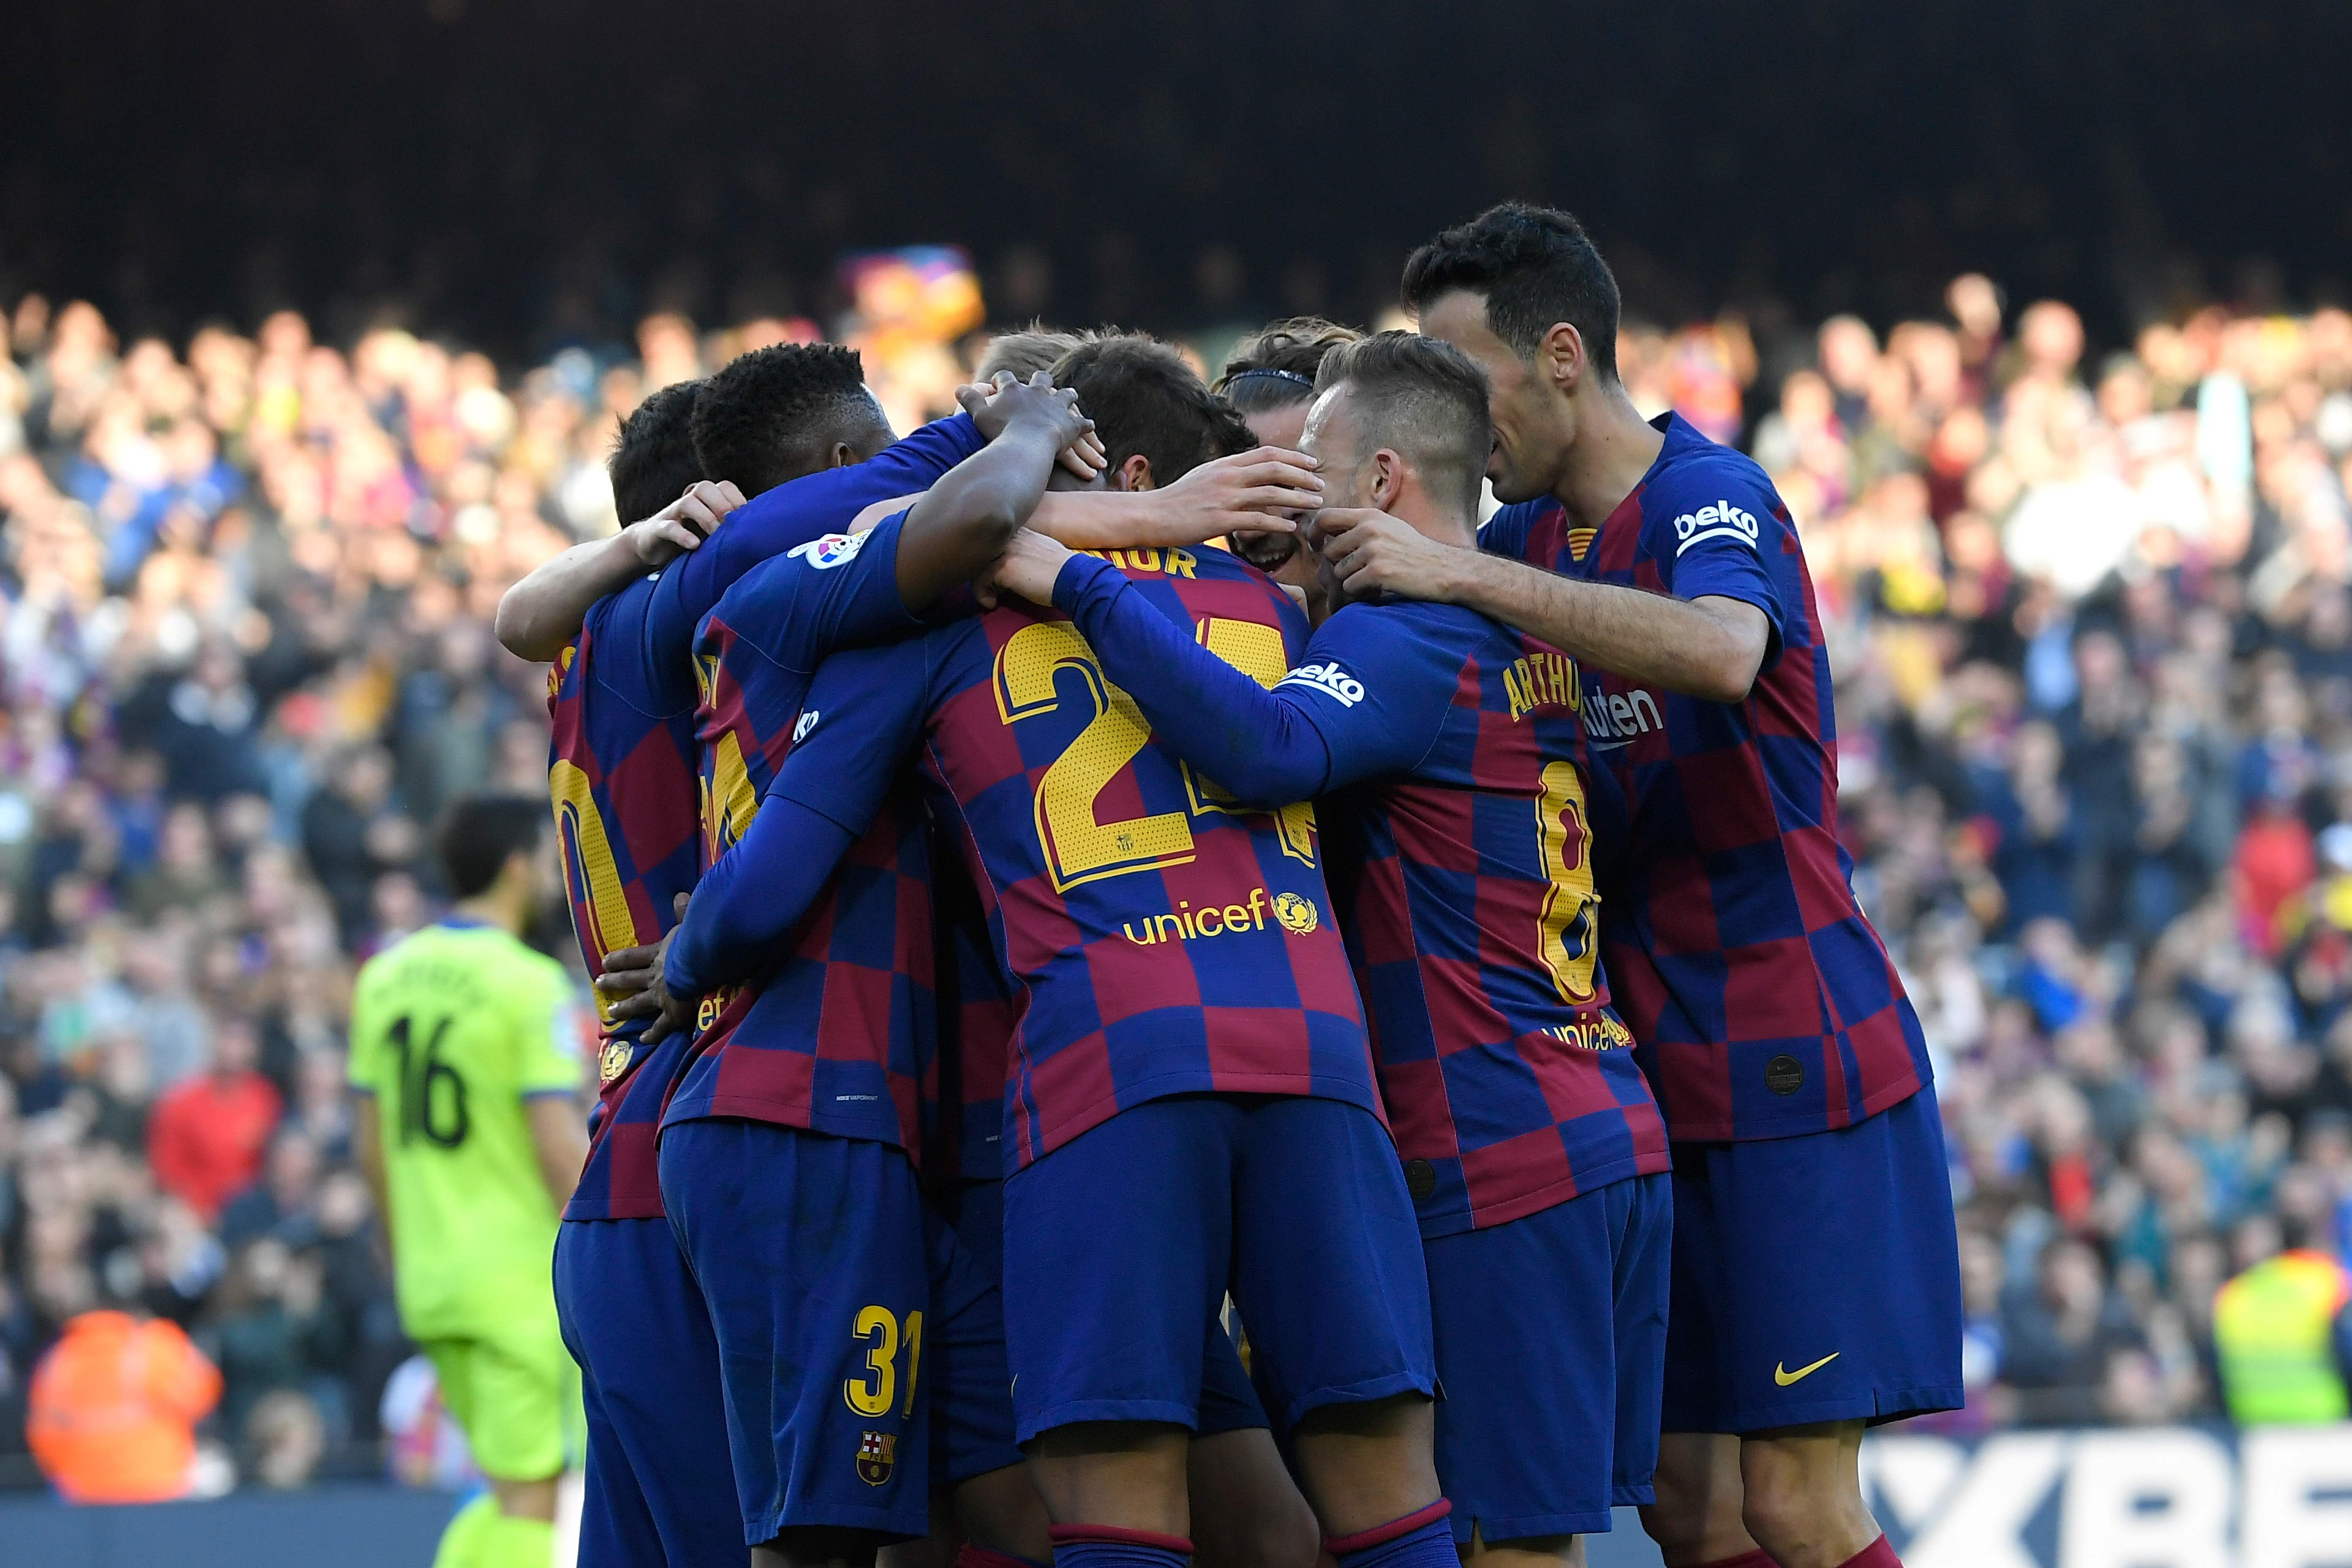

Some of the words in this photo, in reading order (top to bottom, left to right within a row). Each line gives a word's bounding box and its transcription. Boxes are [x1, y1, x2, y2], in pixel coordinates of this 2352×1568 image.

[1673, 499, 1759, 539] beko
[1503, 653, 1585, 723] ARTHU
[1123, 887, 1267, 945] unicef
[1535, 761, 1602, 1004] 8
[385, 1015, 469, 1150] 16
[844, 1305, 923, 1420] 31
